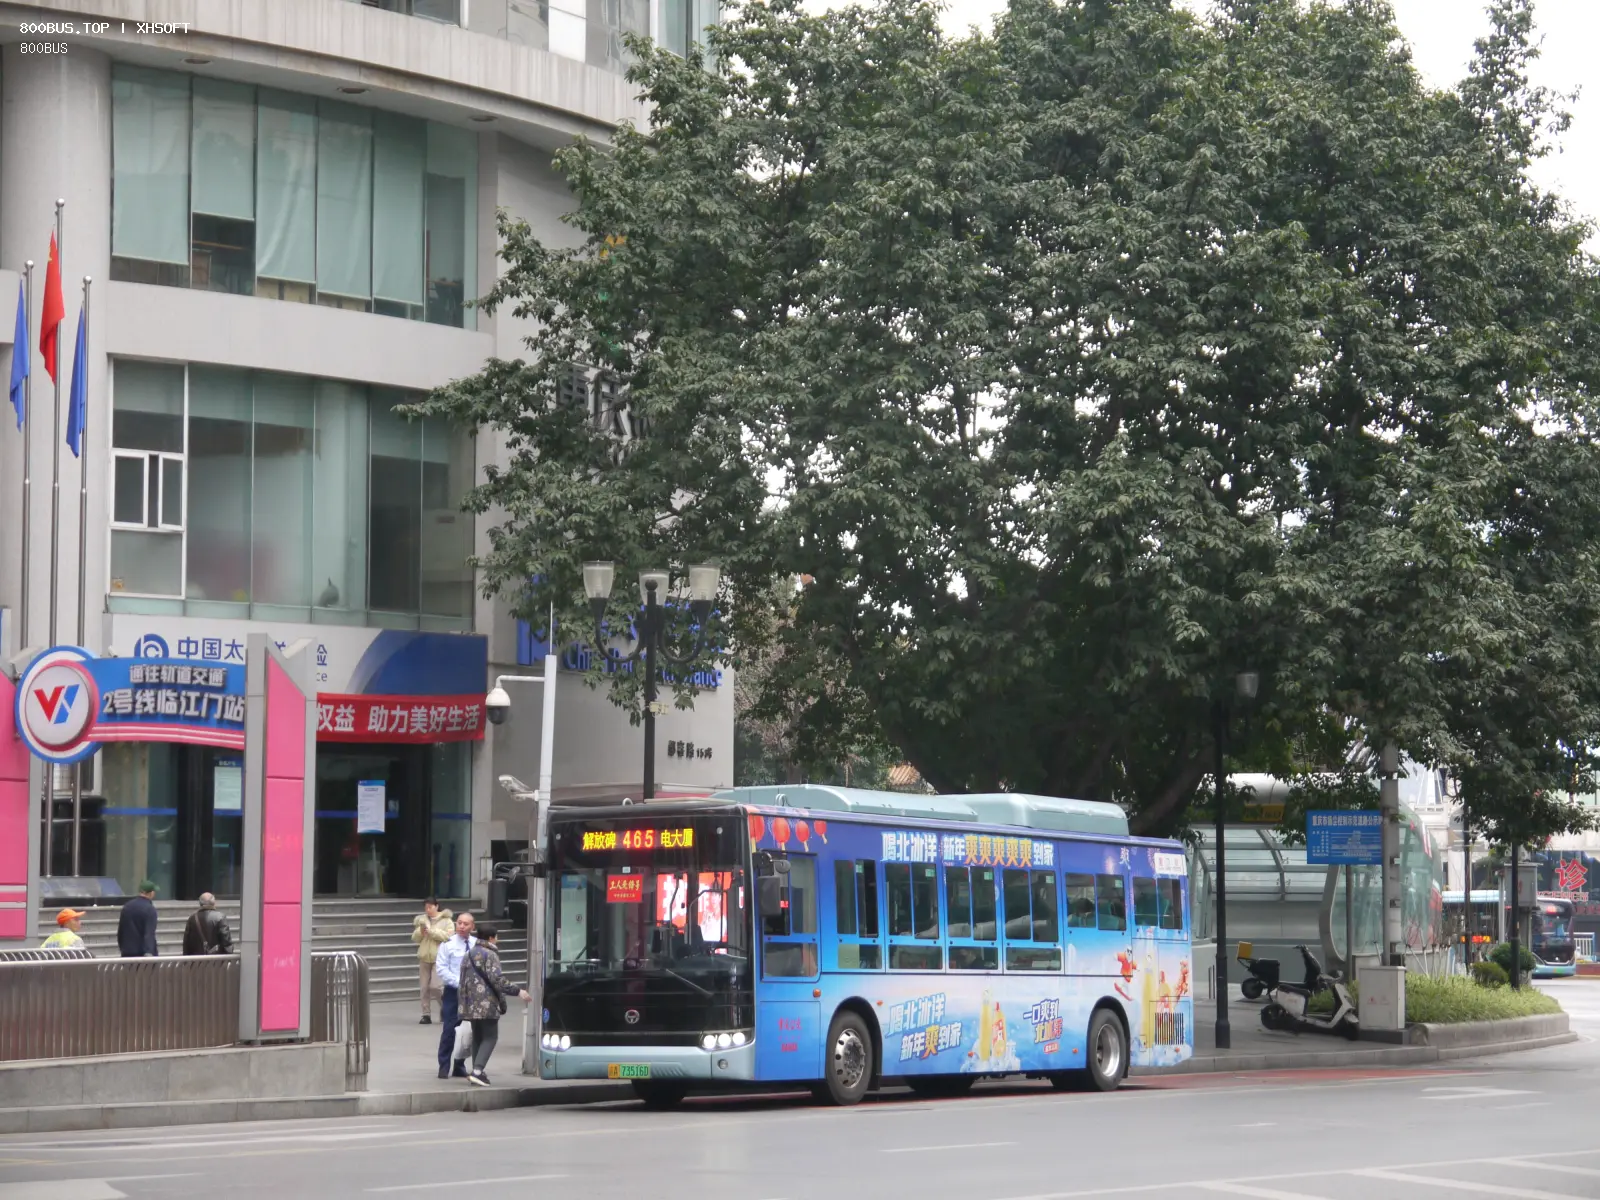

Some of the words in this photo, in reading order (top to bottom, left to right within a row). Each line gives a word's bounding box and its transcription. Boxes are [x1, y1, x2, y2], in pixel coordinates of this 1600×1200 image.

[129, 663, 228, 688] 通往轨道交通
[102, 688, 246, 722] 2号线临江门站
[367, 703, 480, 734] 助力美好生活
[582, 830, 616, 851] 解放碑
[622, 829, 655, 849] 465
[660, 827, 694, 848] 电大厦
[1555, 858, 1588, 890] 诊
